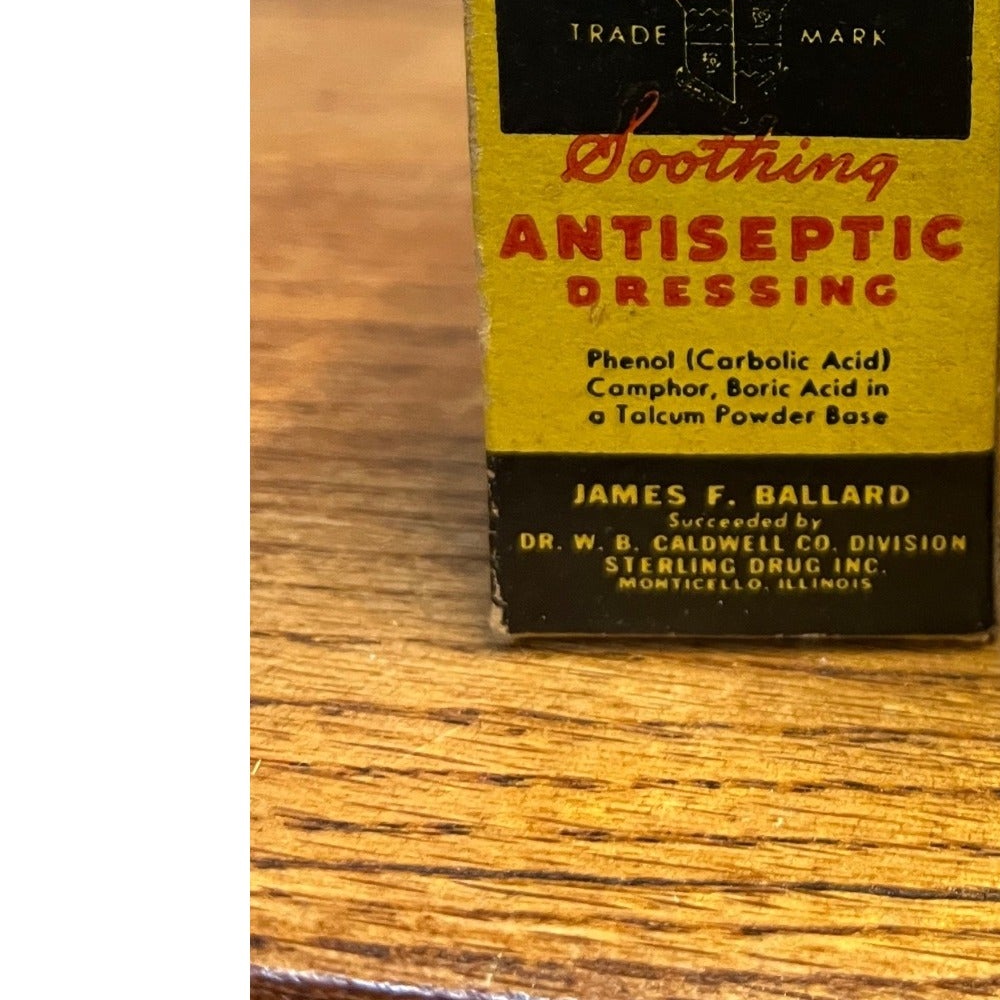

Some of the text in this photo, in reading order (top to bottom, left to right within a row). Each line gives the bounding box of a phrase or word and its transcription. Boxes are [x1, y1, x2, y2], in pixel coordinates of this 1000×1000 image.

[569, 22, 888, 47] TRADE MARK
[561, 89, 900, 202] Soothing
[499, 214, 963, 263] ANTISEPTIC
[566, 274, 897, 308] DRESSING
[587, 348, 891, 372] Phenol (Carbolic Acid)
[586, 376, 889, 401] Camphor, Boric Acid in
[588, 403, 889, 426] a Talcum Powder Base
[574, 483, 910, 506] JAMES F. BALLARD
[668, 512, 822, 530] Succeeded by
[519, 533, 967, 552] DR. W. B. CALDWELL CO. DIVISION
[605, 556, 887, 575] STERLING DRUG INC.
[778, 578, 872, 591] ILLINOIS
